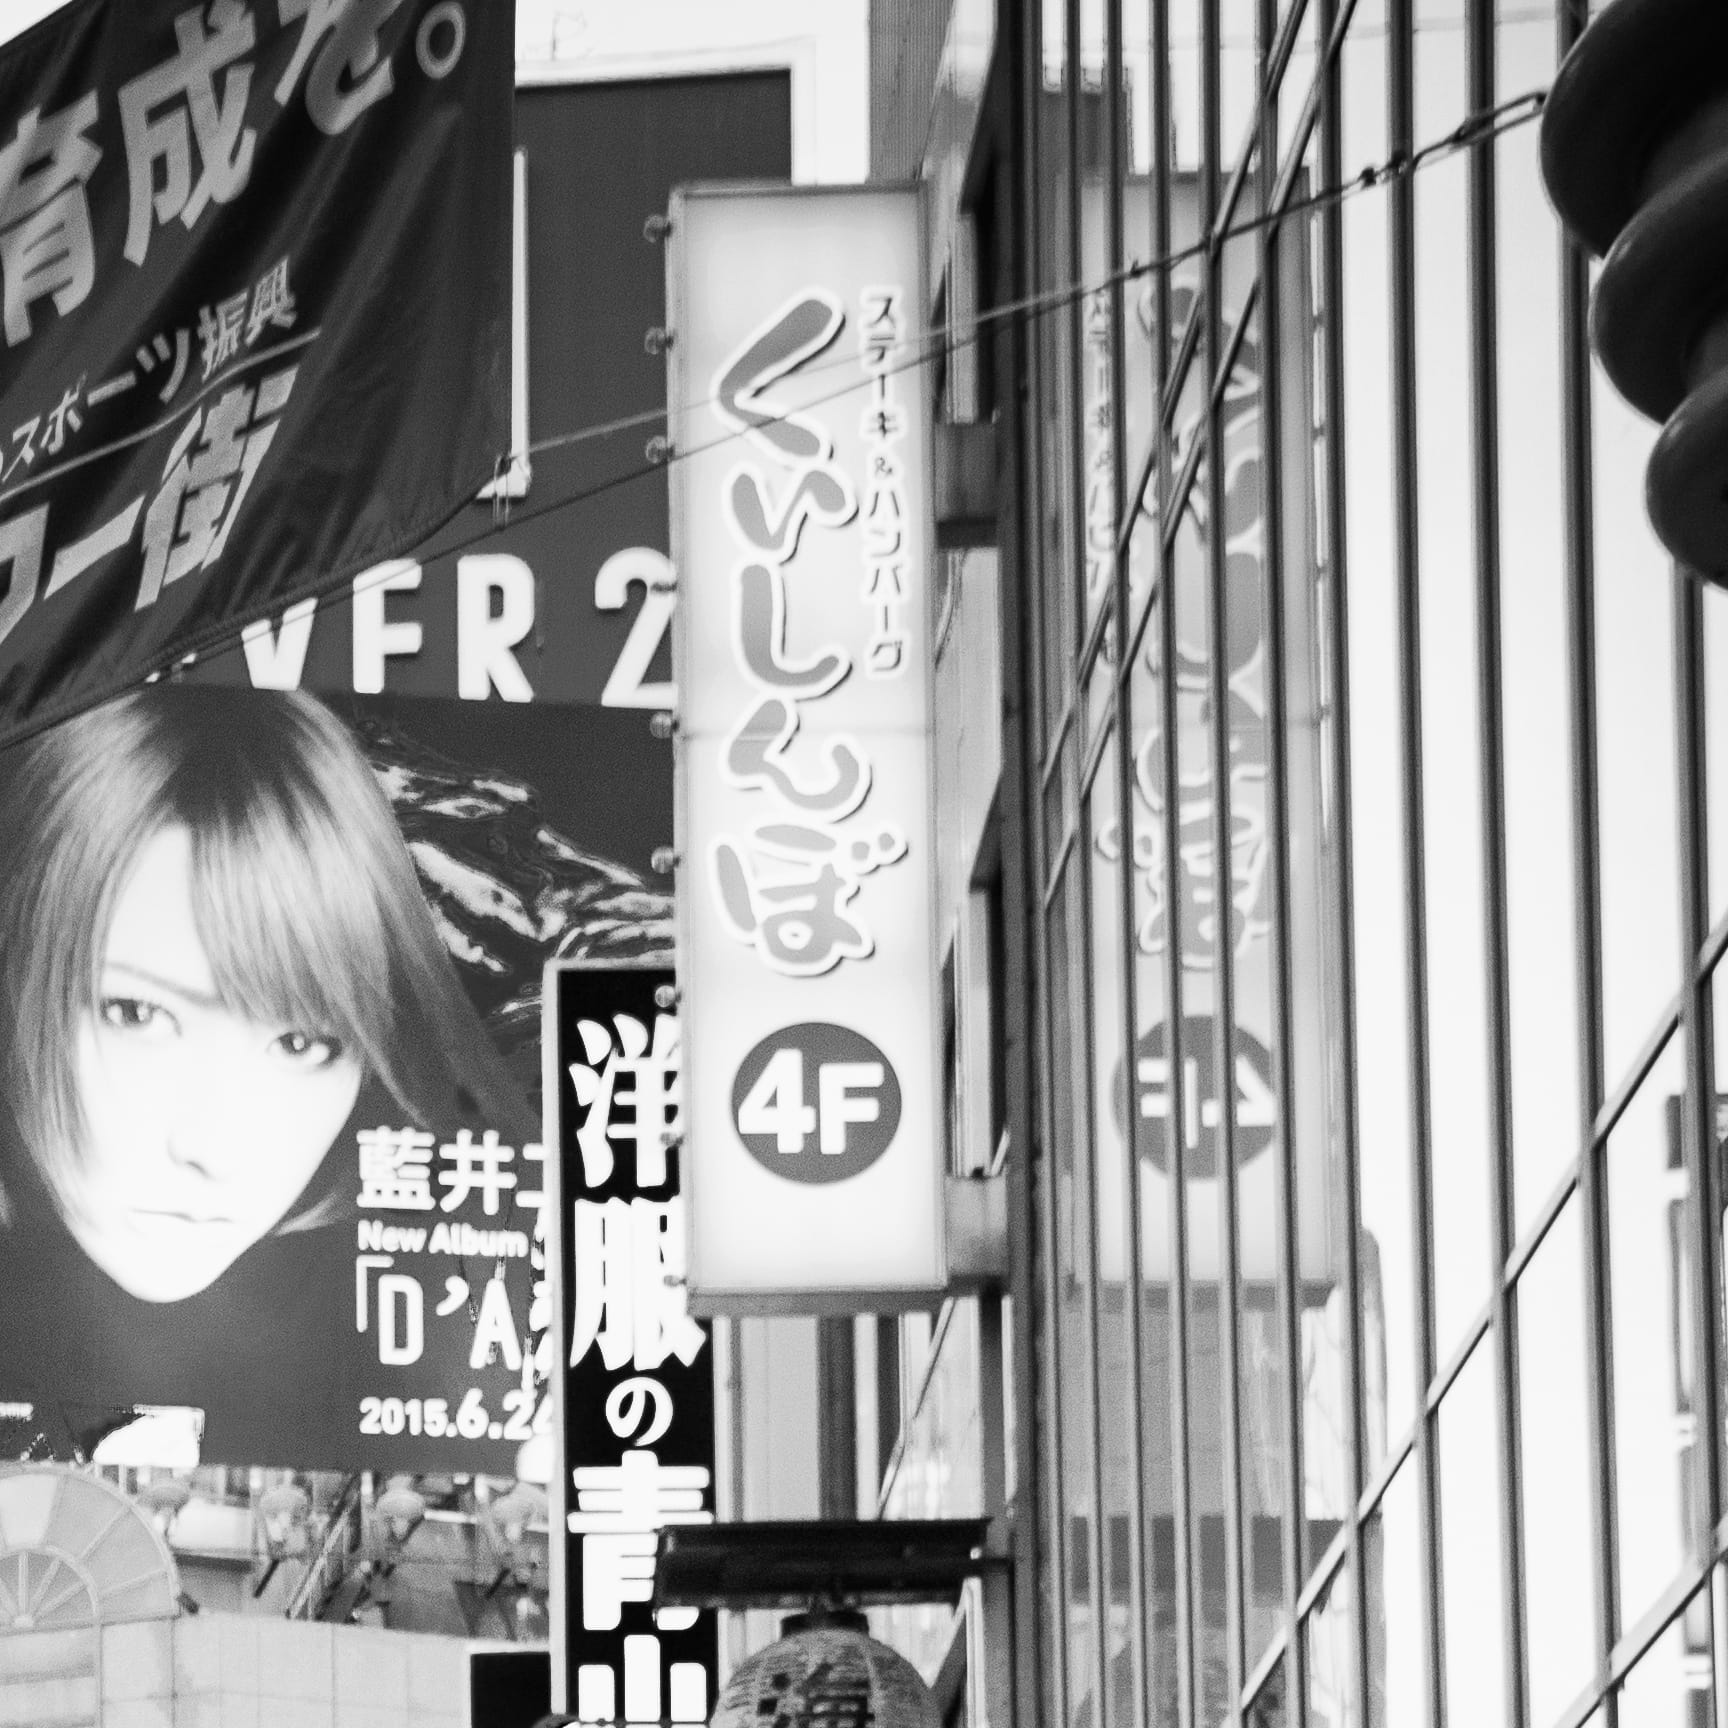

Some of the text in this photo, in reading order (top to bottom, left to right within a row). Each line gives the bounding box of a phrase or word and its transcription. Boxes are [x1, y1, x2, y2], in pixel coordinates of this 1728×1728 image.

[738, 1048, 886, 1156] 4F
[358, 1219, 530, 1258] New Album
